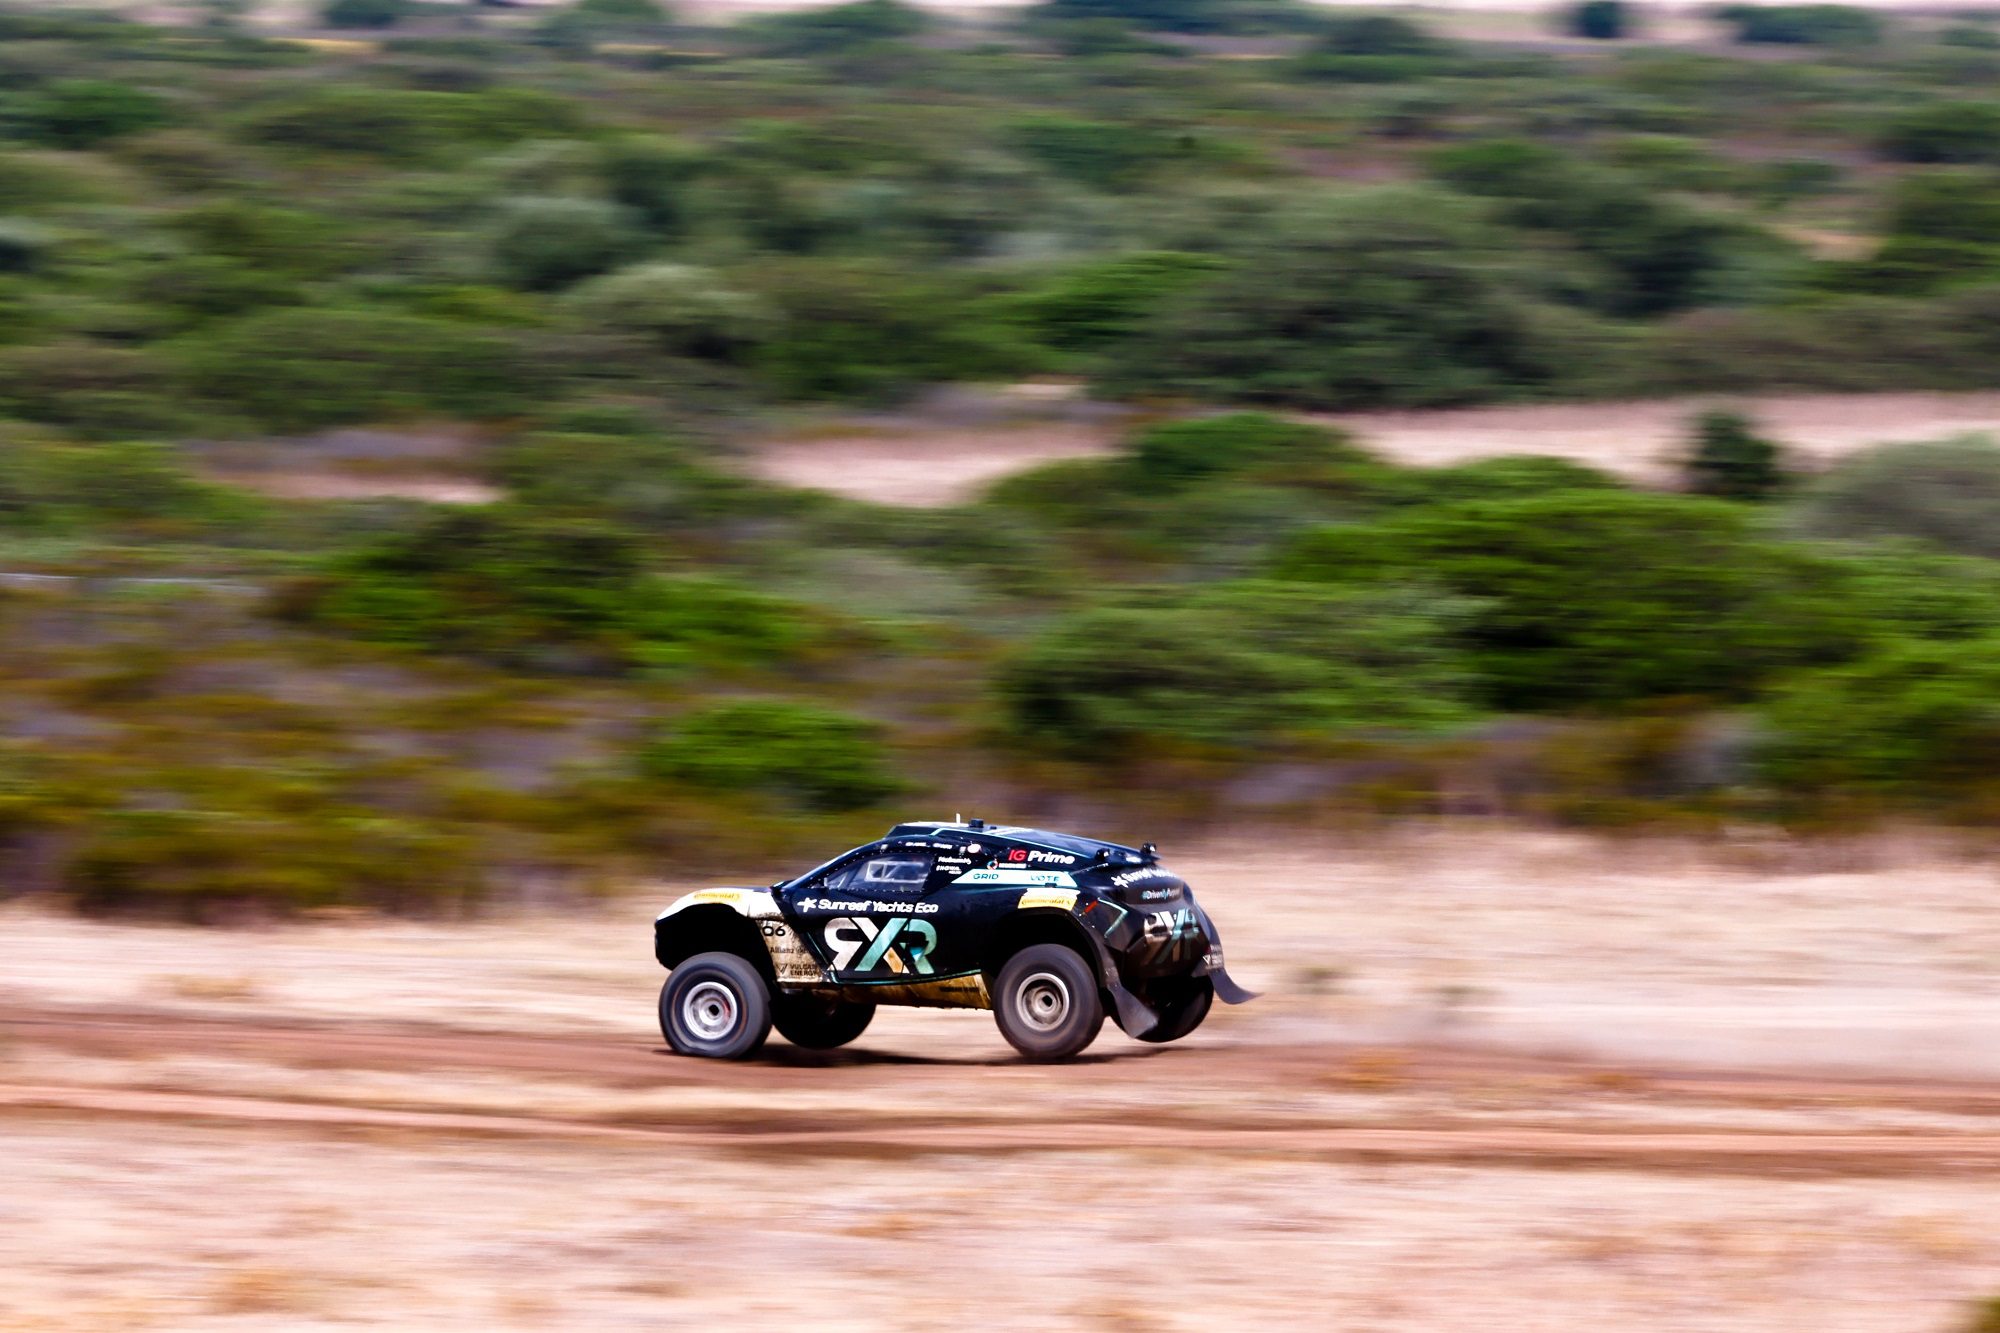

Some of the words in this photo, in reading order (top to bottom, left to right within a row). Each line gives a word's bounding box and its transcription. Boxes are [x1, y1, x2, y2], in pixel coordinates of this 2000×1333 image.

[1008, 849, 1027, 861] IG
[1027, 850, 1075, 864] Prime
[818, 899, 872, 911] Sunreef
[873, 901, 914, 912] Yachts
[914, 902, 939, 913] Eco
